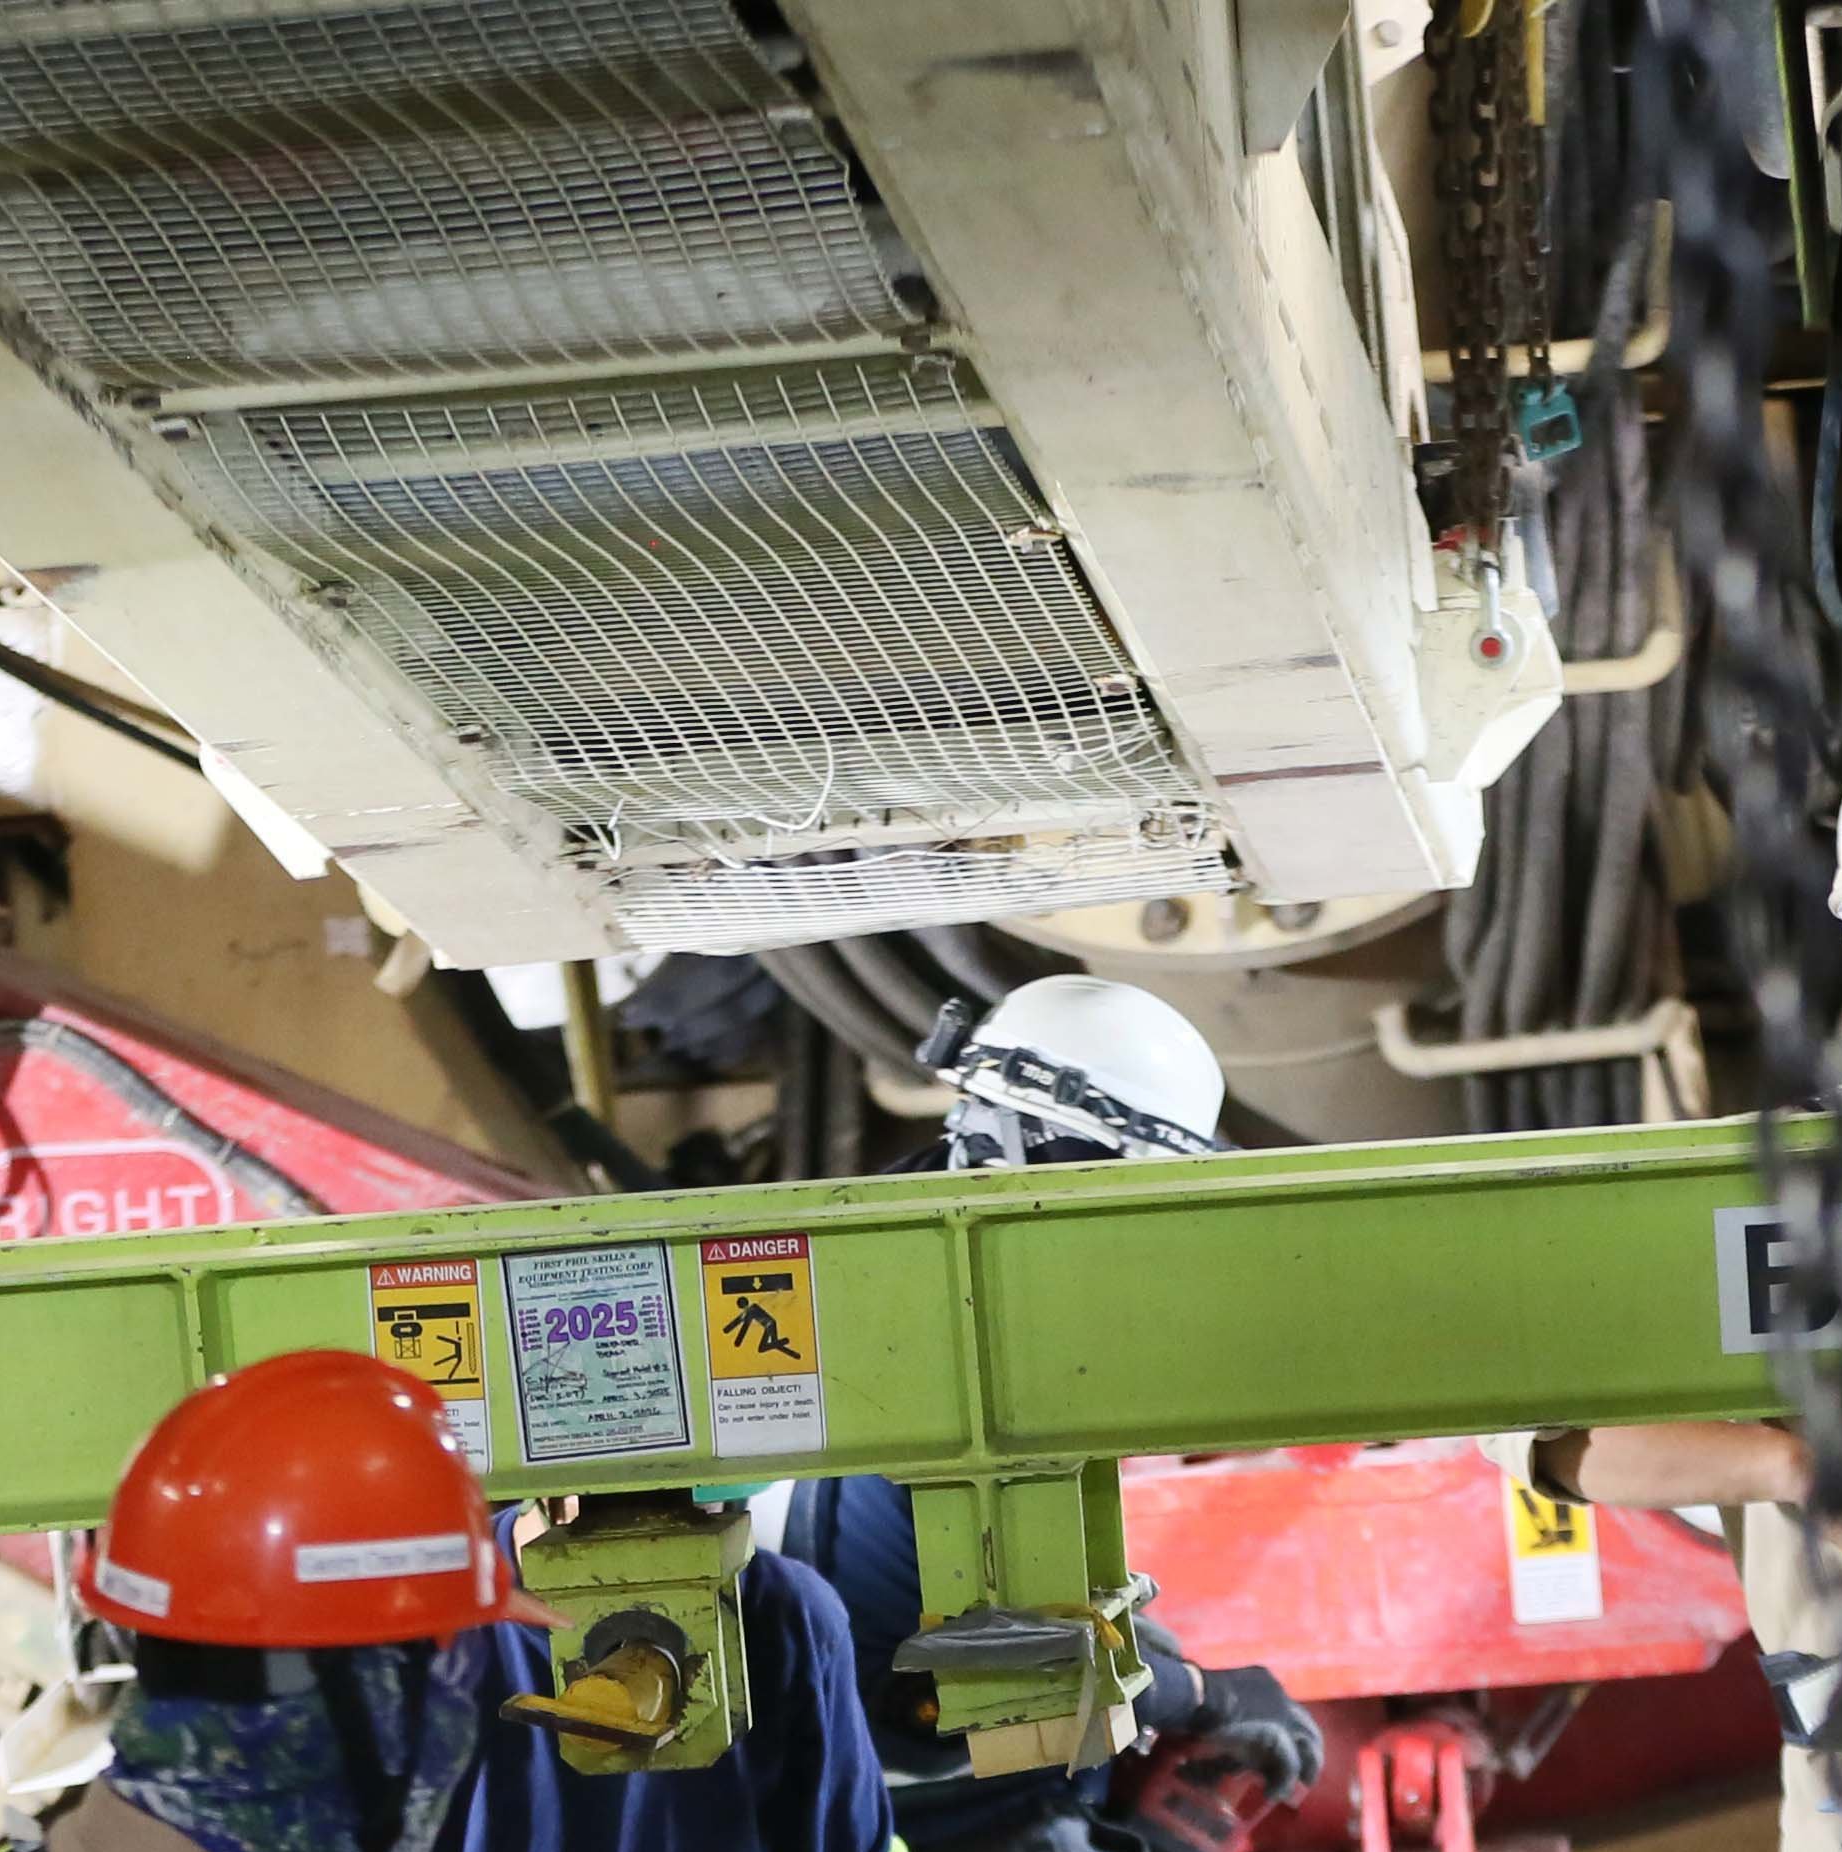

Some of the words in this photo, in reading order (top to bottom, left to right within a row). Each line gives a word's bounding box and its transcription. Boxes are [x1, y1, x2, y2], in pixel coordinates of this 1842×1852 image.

[728, 1238, 800, 1258] DANGER
[534, 1260, 563, 1270] FIRST
[565, 1257, 589, 1268] PHIL
[593, 1253, 625, 1264] SKILLS
[397, 1265, 472, 1285] WARNING
[519, 1269, 579, 1284] EQUIPMENT
[580, 1265, 624, 1279] TESTING
[545, 1301, 638, 1343] 2025
[717, 1388, 757, 1397] FALLING
[761, 1384, 801, 1395] OBJECT!
[718, 1403, 732, 1411] Can
[769, 1412, 789, 1420] under
